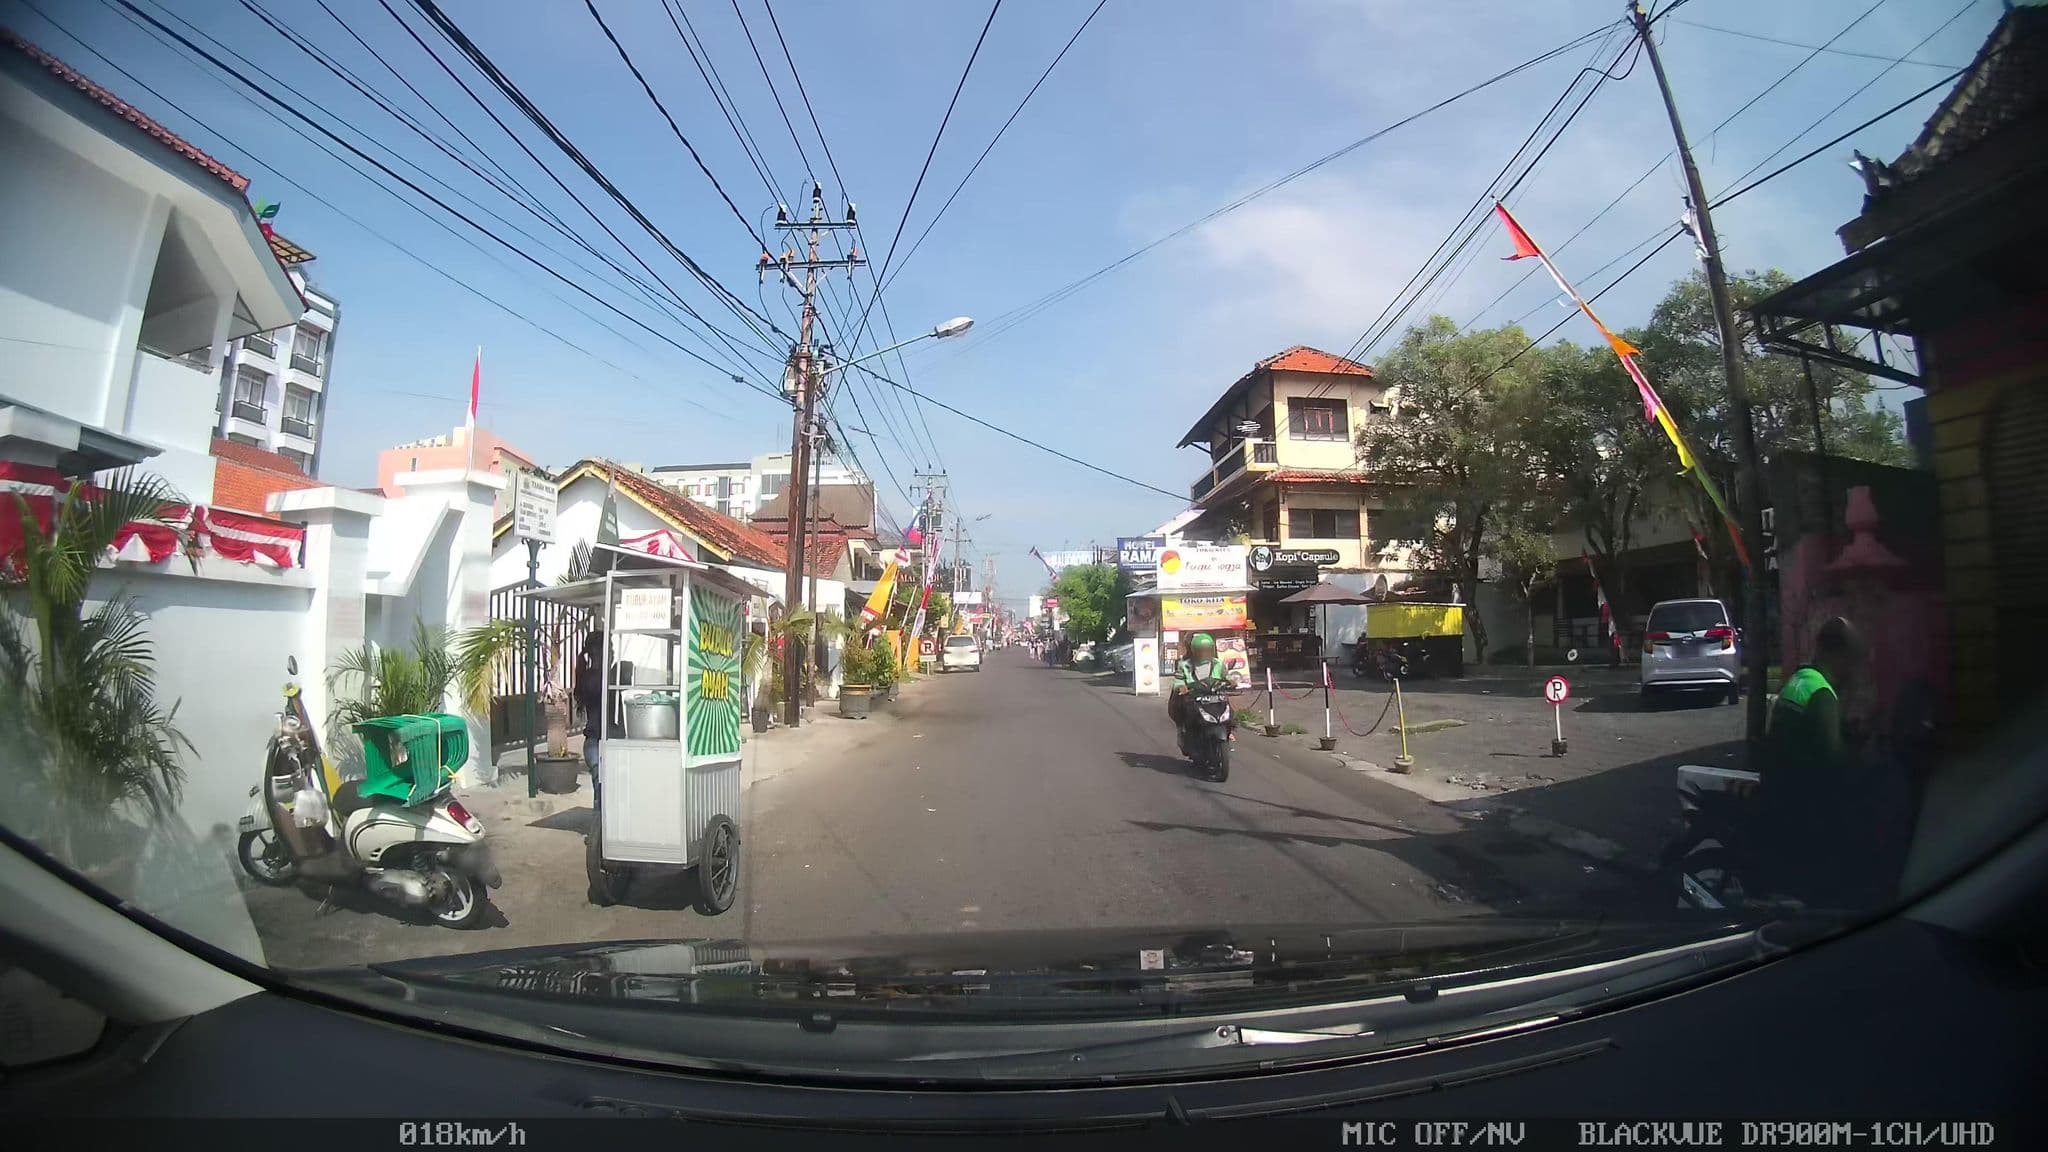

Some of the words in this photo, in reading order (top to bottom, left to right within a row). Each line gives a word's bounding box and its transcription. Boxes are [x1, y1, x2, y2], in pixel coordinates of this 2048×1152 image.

[1275, 551, 1298, 564] Kopi
[1301, 551, 1339, 564] Capsule
[700, 622, 733, 657] BUBUR
[701, 669, 729, 700] AYAM
